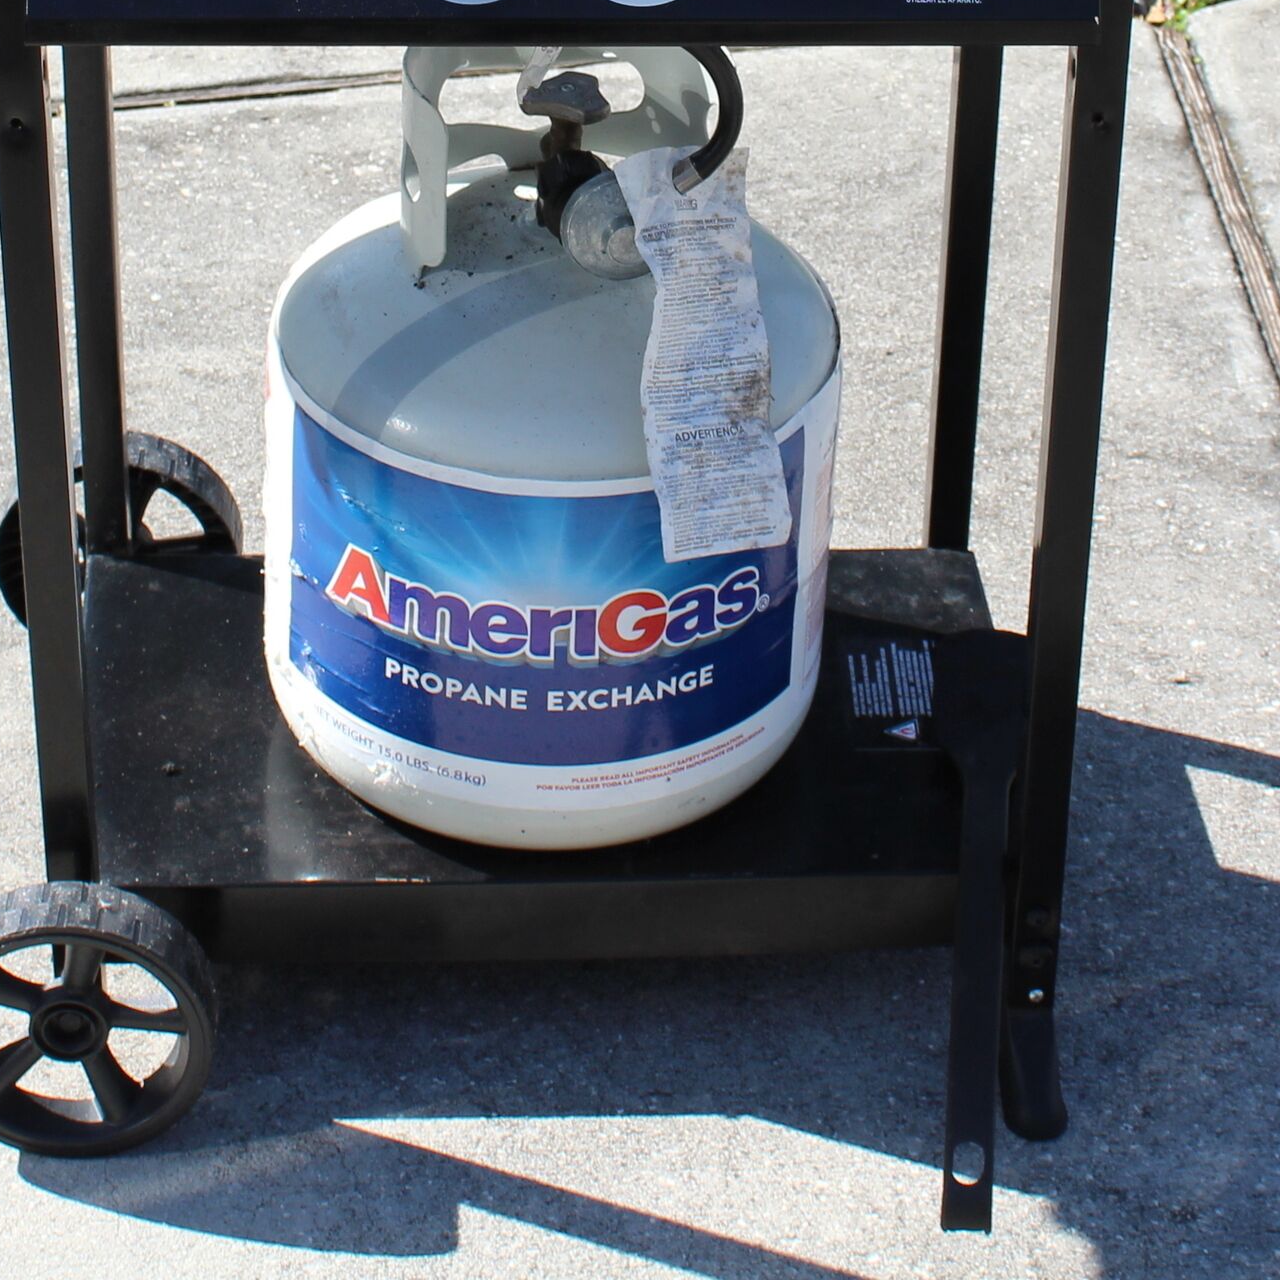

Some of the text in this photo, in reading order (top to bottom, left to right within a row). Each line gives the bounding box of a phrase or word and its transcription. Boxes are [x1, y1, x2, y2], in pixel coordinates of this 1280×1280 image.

[675, 425, 745, 442] ADVERTENCIA
[385, 657, 714, 711] PROPANE EXCHANGE
[333, 717, 374, 749] WEIGHT
[378, 744, 402, 762] 15.0
[636, 762, 675, 776] IMPORTANT
